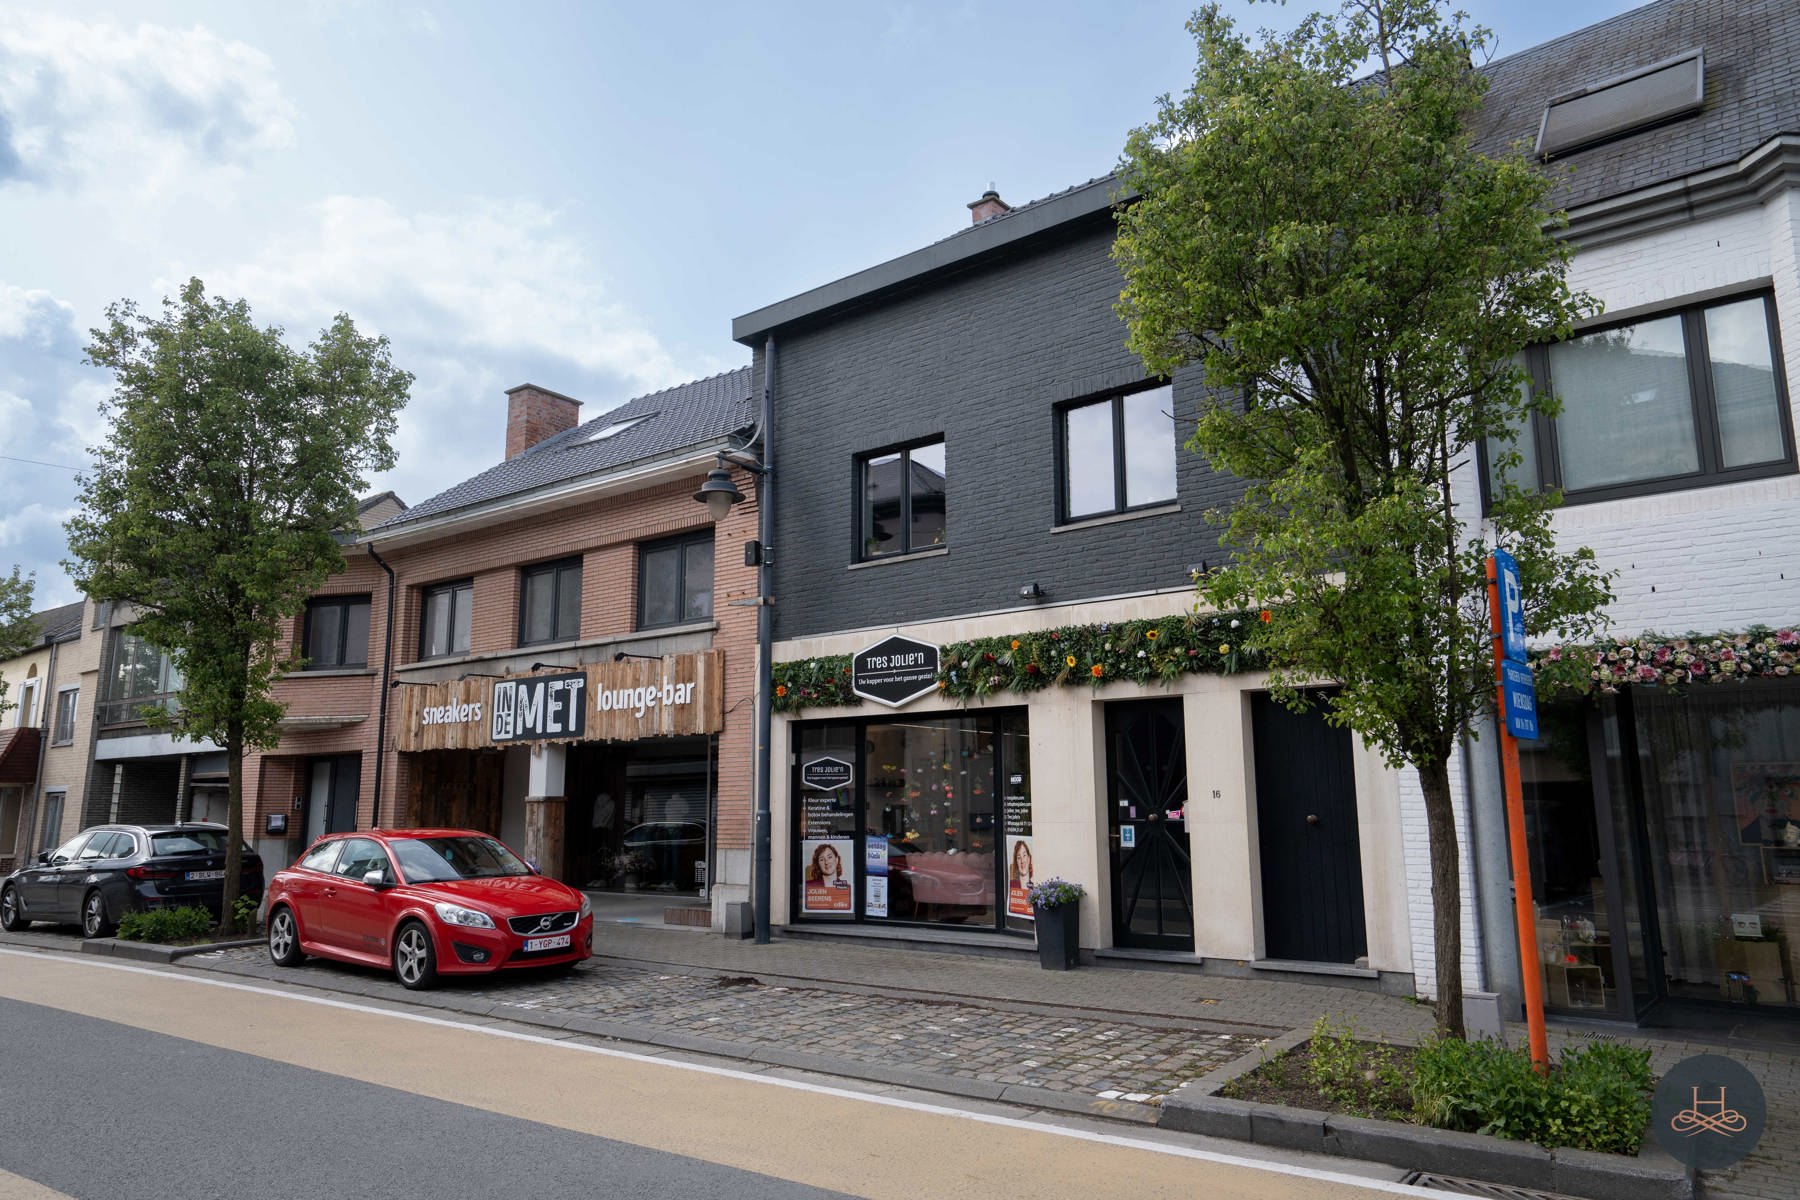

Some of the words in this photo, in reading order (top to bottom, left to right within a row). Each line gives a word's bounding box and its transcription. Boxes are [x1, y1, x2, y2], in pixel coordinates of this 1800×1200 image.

[1504, 568, 1519, 643] P
[867, 678, 883, 686] kapper
[422, 697, 482, 725] sneakers
[497, 685, 513, 713] IN
[515, 678, 585, 735] MET
[597, 675, 695, 719] lounge-bar
[495, 713, 511, 736] DE
[1212, 790, 1221, 799] 16
